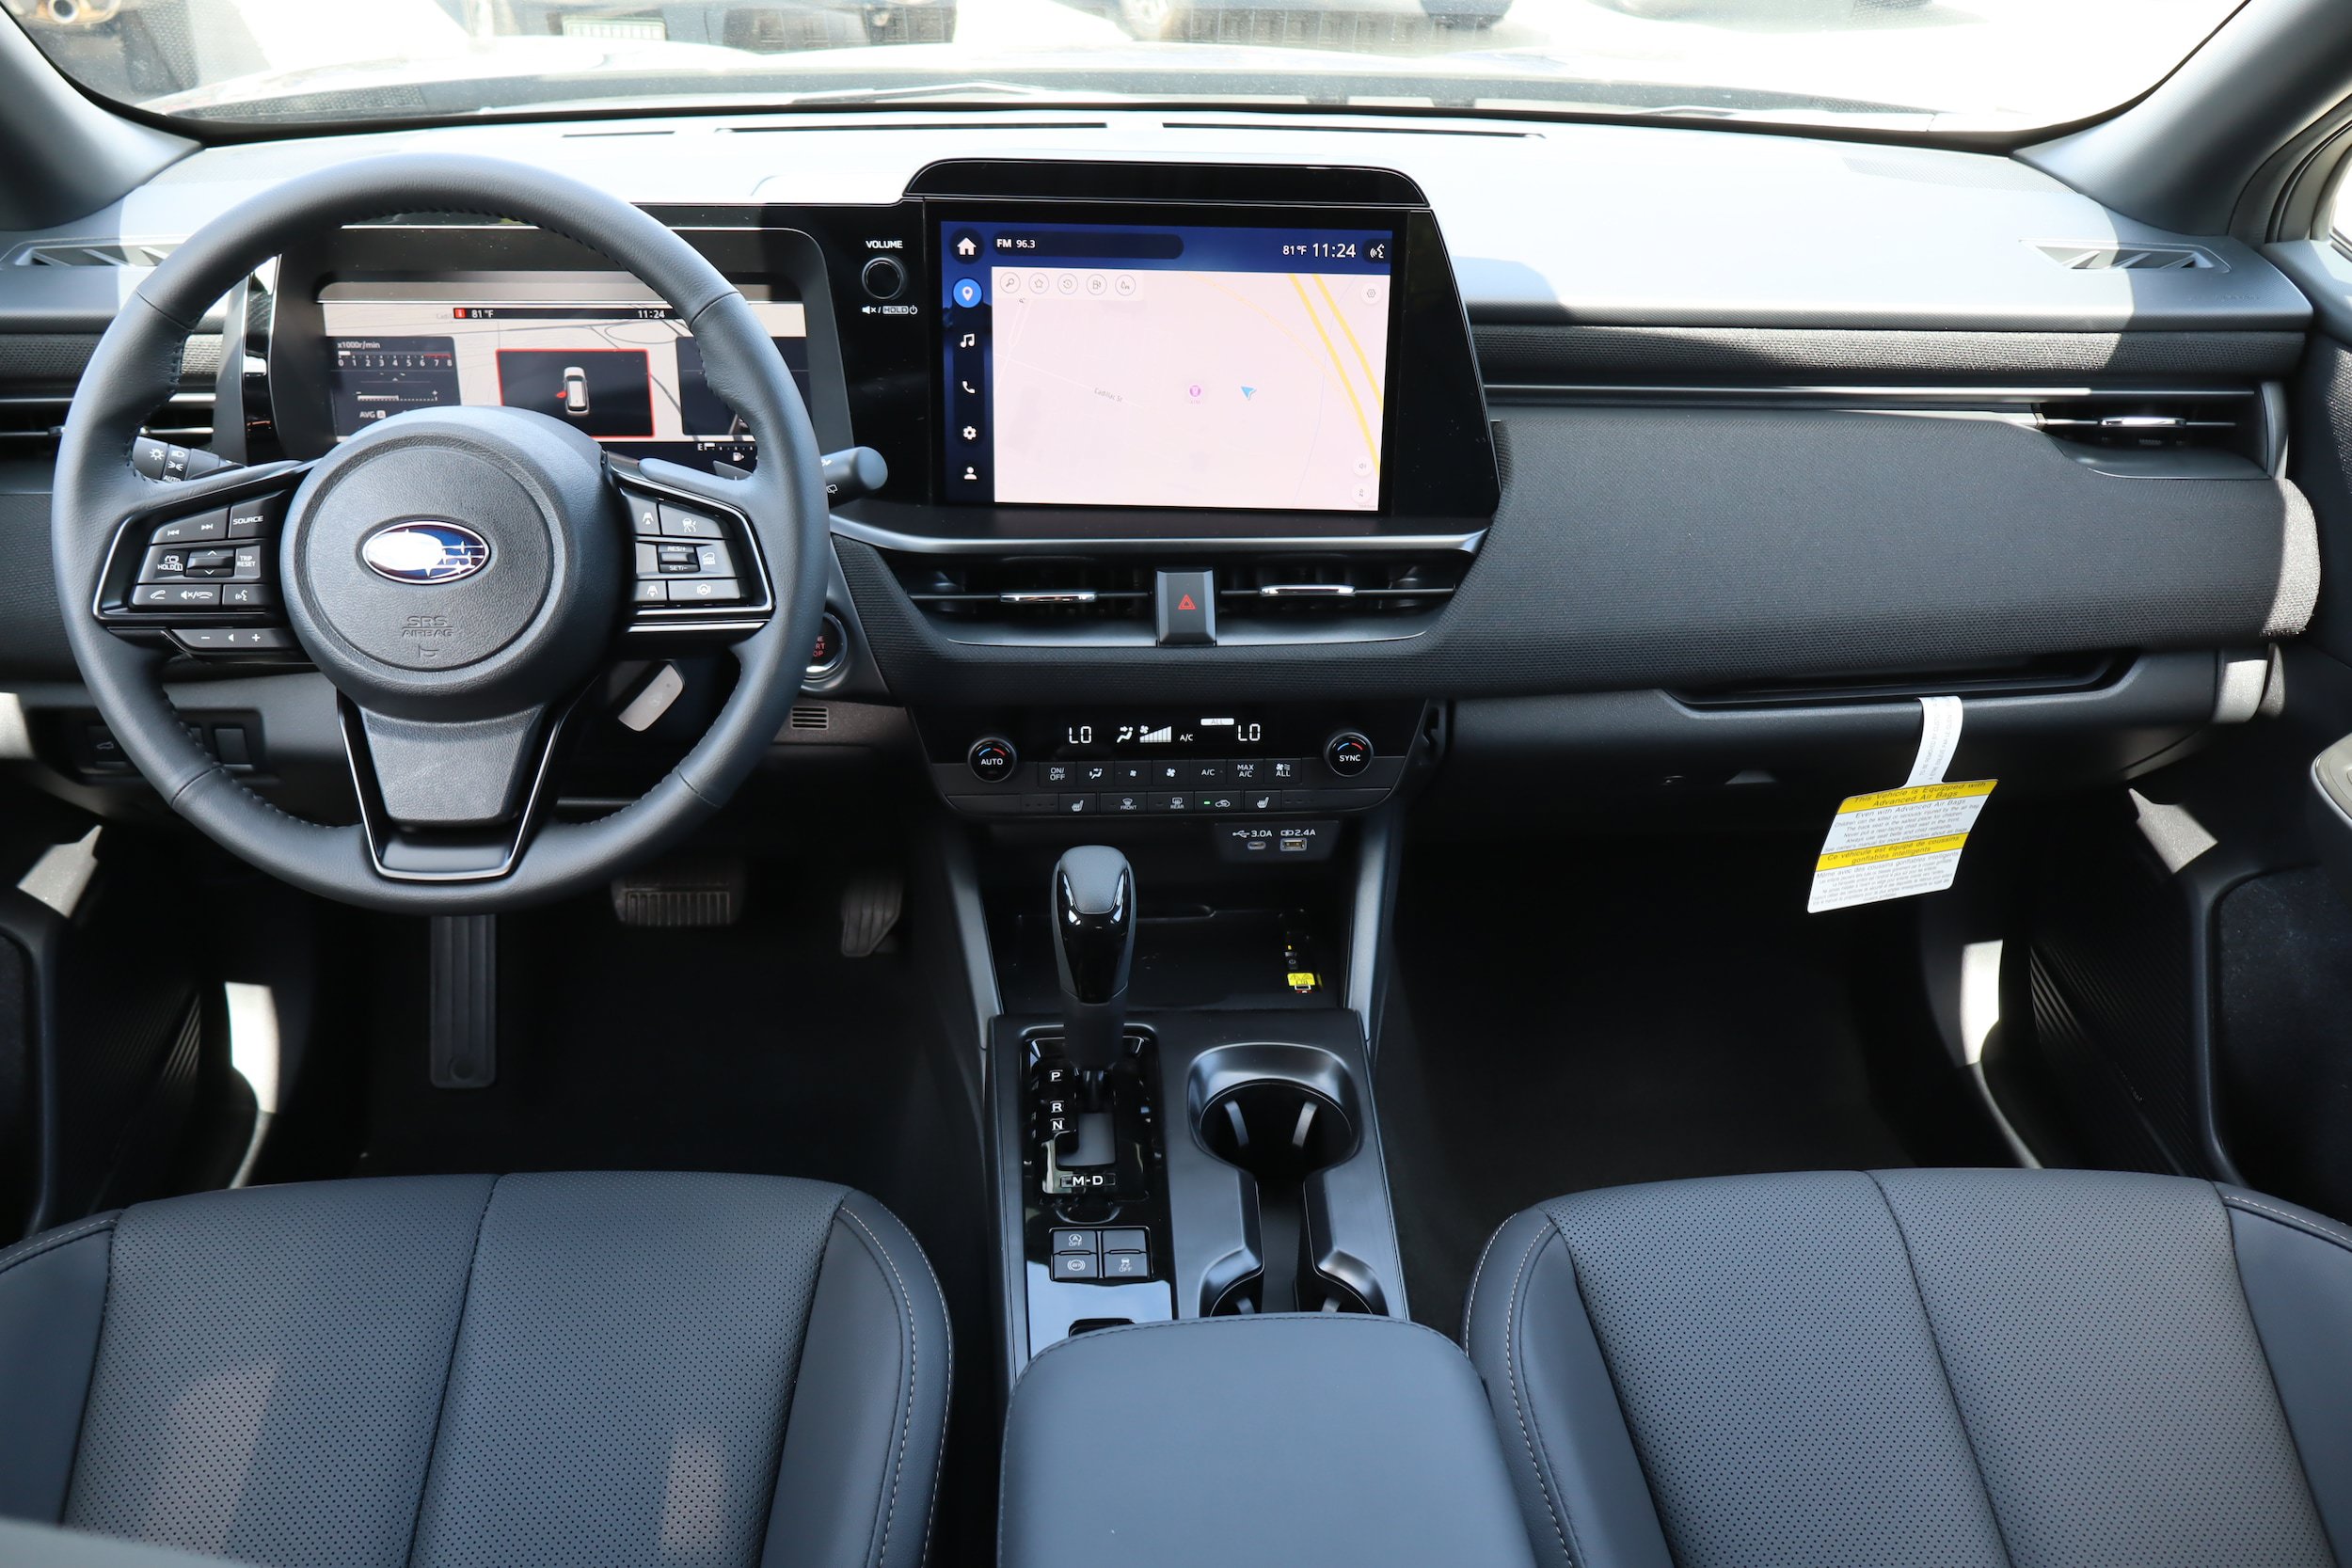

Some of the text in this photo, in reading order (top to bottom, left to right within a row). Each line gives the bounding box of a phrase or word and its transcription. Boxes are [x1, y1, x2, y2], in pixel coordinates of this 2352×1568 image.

[866, 240, 903, 249] VOLUME
[997, 239, 1036, 249] FM 96.3
[1312, 243, 1357, 259] 11:24
[471, 309, 483, 319] 81
[638, 309, 665, 320] 11:24
[882, 306, 909, 314] HOLD
[338, 341, 381, 350] x1000r/min
[359, 410, 375, 419] AVG
[233, 515, 263, 525] SOURCE
[406, 616, 447, 626] SRS
[402, 629, 454, 638] AIRBAG
[1068, 725, 1092, 744] LO
[1237, 723, 1261, 741] LO
[1179, 734, 1194, 742] A/C
[1876, 790, 1908, 799] Vehicle
[1922, 784, 1965, 793] Equipped
[1873, 796, 1916, 806] Advanced
[1935, 790, 1959, 799] Bags
[1895, 803, 1931, 812] Advanced
[1892, 847, 1931, 857] intelligents
[1050, 1070, 1062, 1081] P
[1051, 1101, 1064, 1112] R
[1052, 1119, 1063, 1130] N
[1072, 1176, 1104, 1186] M-D
